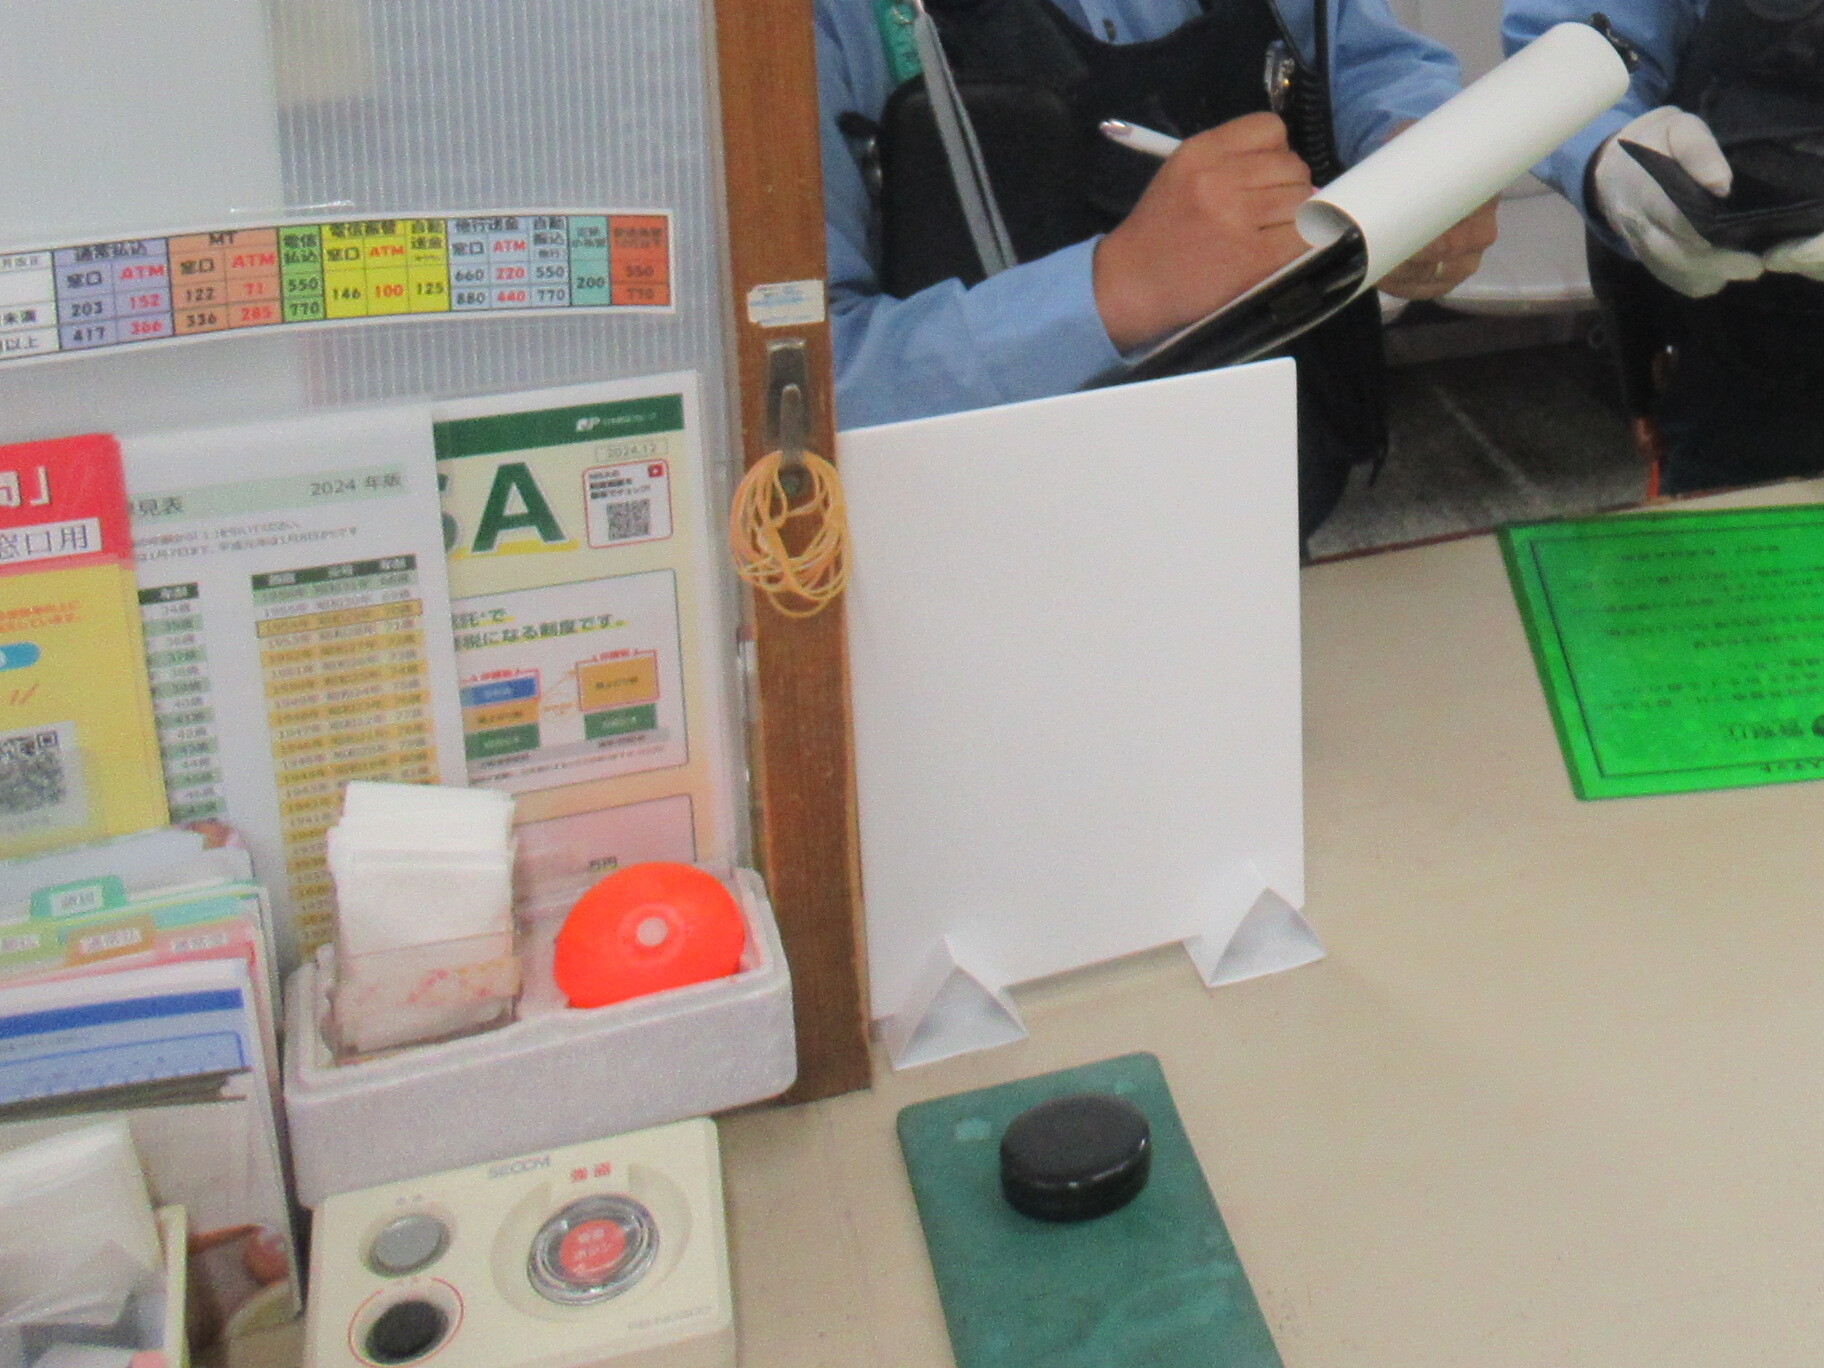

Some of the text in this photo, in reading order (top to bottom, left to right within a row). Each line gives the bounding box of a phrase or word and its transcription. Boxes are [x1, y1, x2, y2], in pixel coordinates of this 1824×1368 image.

[208, 231, 236, 246] MT
[493, 238, 528, 253] ATM
[327, 246, 361, 263] 窓口
[368, 244, 406, 258] ATM
[180, 258, 215, 275] 窓口
[231, 252, 276, 270] ATM
[66, 270, 103, 289] 窓口
[120, 264, 166, 281] ATM
[454, 268, 485, 283] 660
[495, 266, 527, 280] 220
[535, 265, 567, 280] 550
[288, 276, 319, 293] 550
[373, 283, 405, 299] 100
[415, 281, 445, 297] 125
[576, 276, 605, 290] 200
[129, 292, 162, 311] 152
[185, 286, 216, 304] 122
[331, 285, 363, 302] 146
[456, 291, 487, 306] 880
[496, 289, 527, 303] 440
[536, 287, 567, 303] 770
[71, 300, 104, 319] 203
[240, 305, 273, 323] 285
[289, 300, 321, 317] 770
[185, 310, 218, 329] 336
[72, 325, 106, 344] 417
[606, 443, 659, 461] 2024.12
[310, 472, 403, 498] 2024 年版
[0, 522, 89, 561] 窓口用
